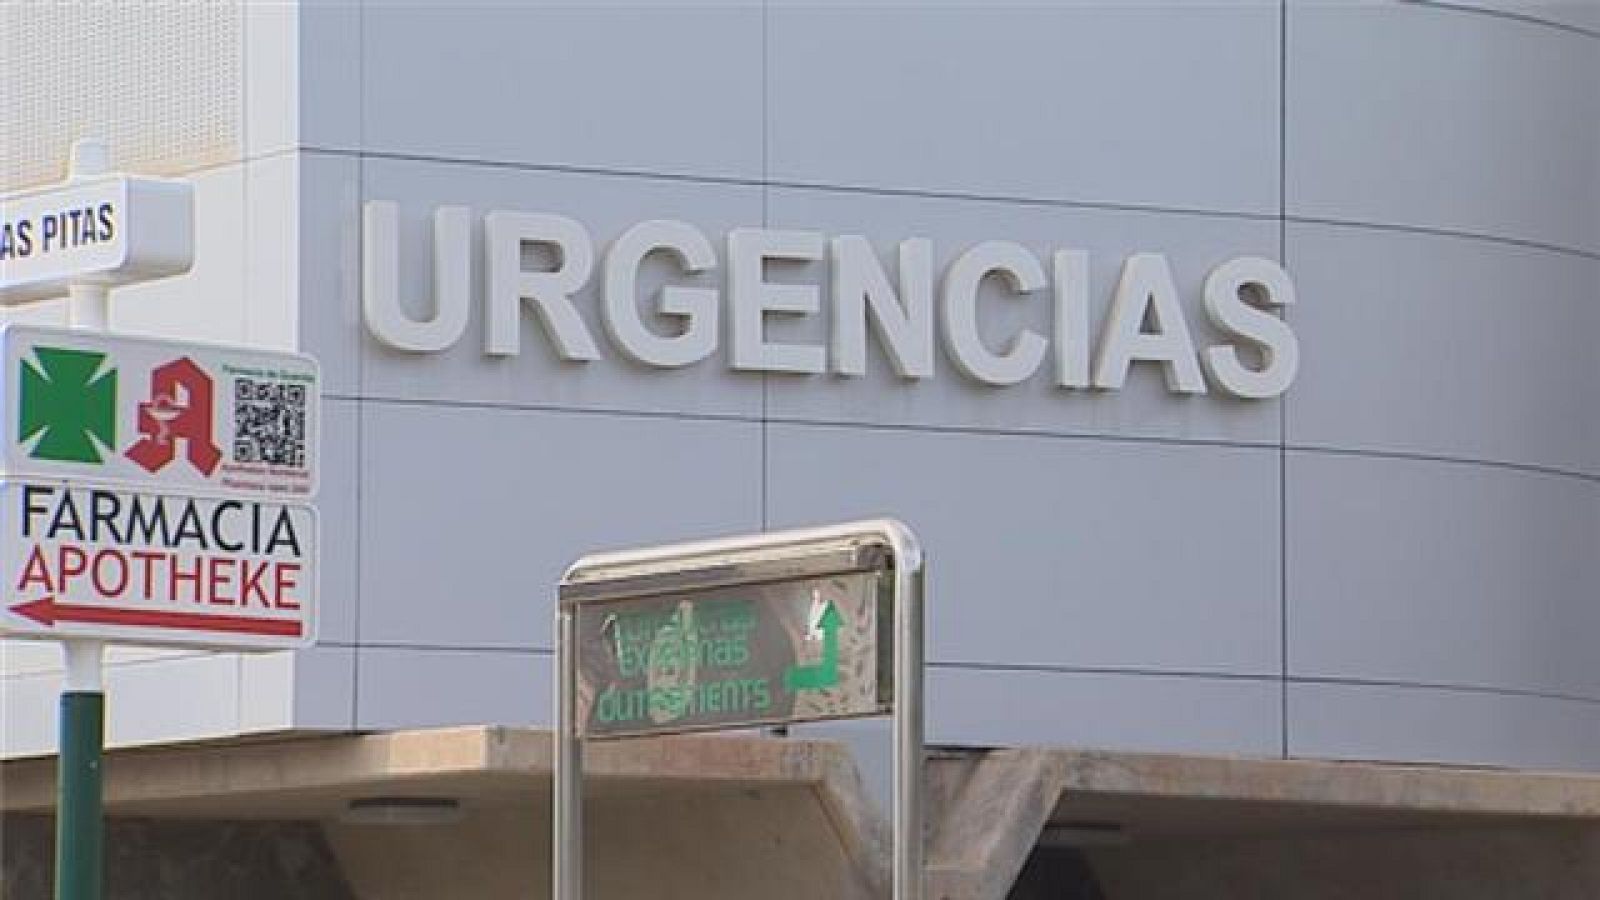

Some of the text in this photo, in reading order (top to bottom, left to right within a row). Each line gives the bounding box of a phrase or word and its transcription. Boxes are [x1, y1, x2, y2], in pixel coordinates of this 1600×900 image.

[43, 203, 113, 252] PITAS
[361, 200, 1299, 399] URGENCIAS
[21, 485, 301, 556] FARMACIA
[17, 545, 301, 610] APOTHEKE
